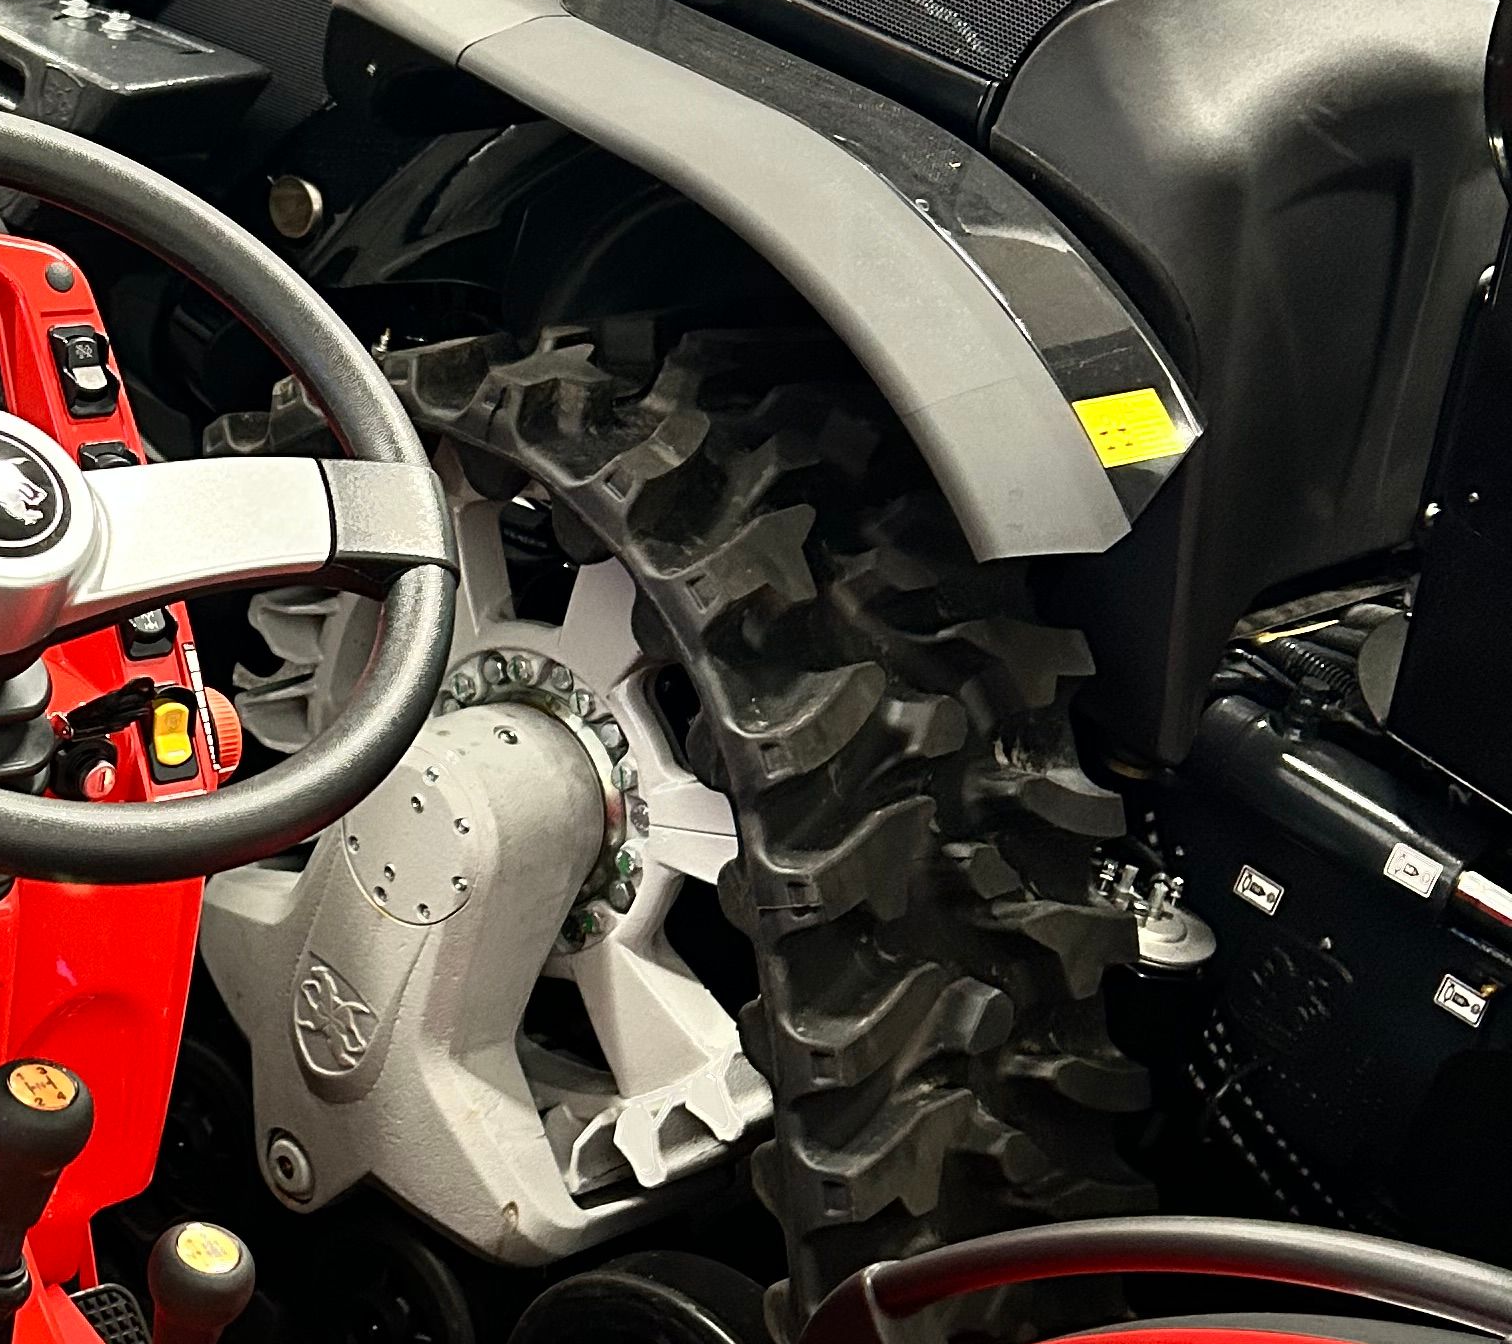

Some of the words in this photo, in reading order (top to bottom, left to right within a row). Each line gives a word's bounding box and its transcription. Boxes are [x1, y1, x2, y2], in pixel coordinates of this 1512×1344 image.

[36, 1066, 48, 1075] 3
[16, 1072, 25, 1081] 1
[57, 1091, 66, 1100] 4
[34, 1097, 46, 1107] 2
